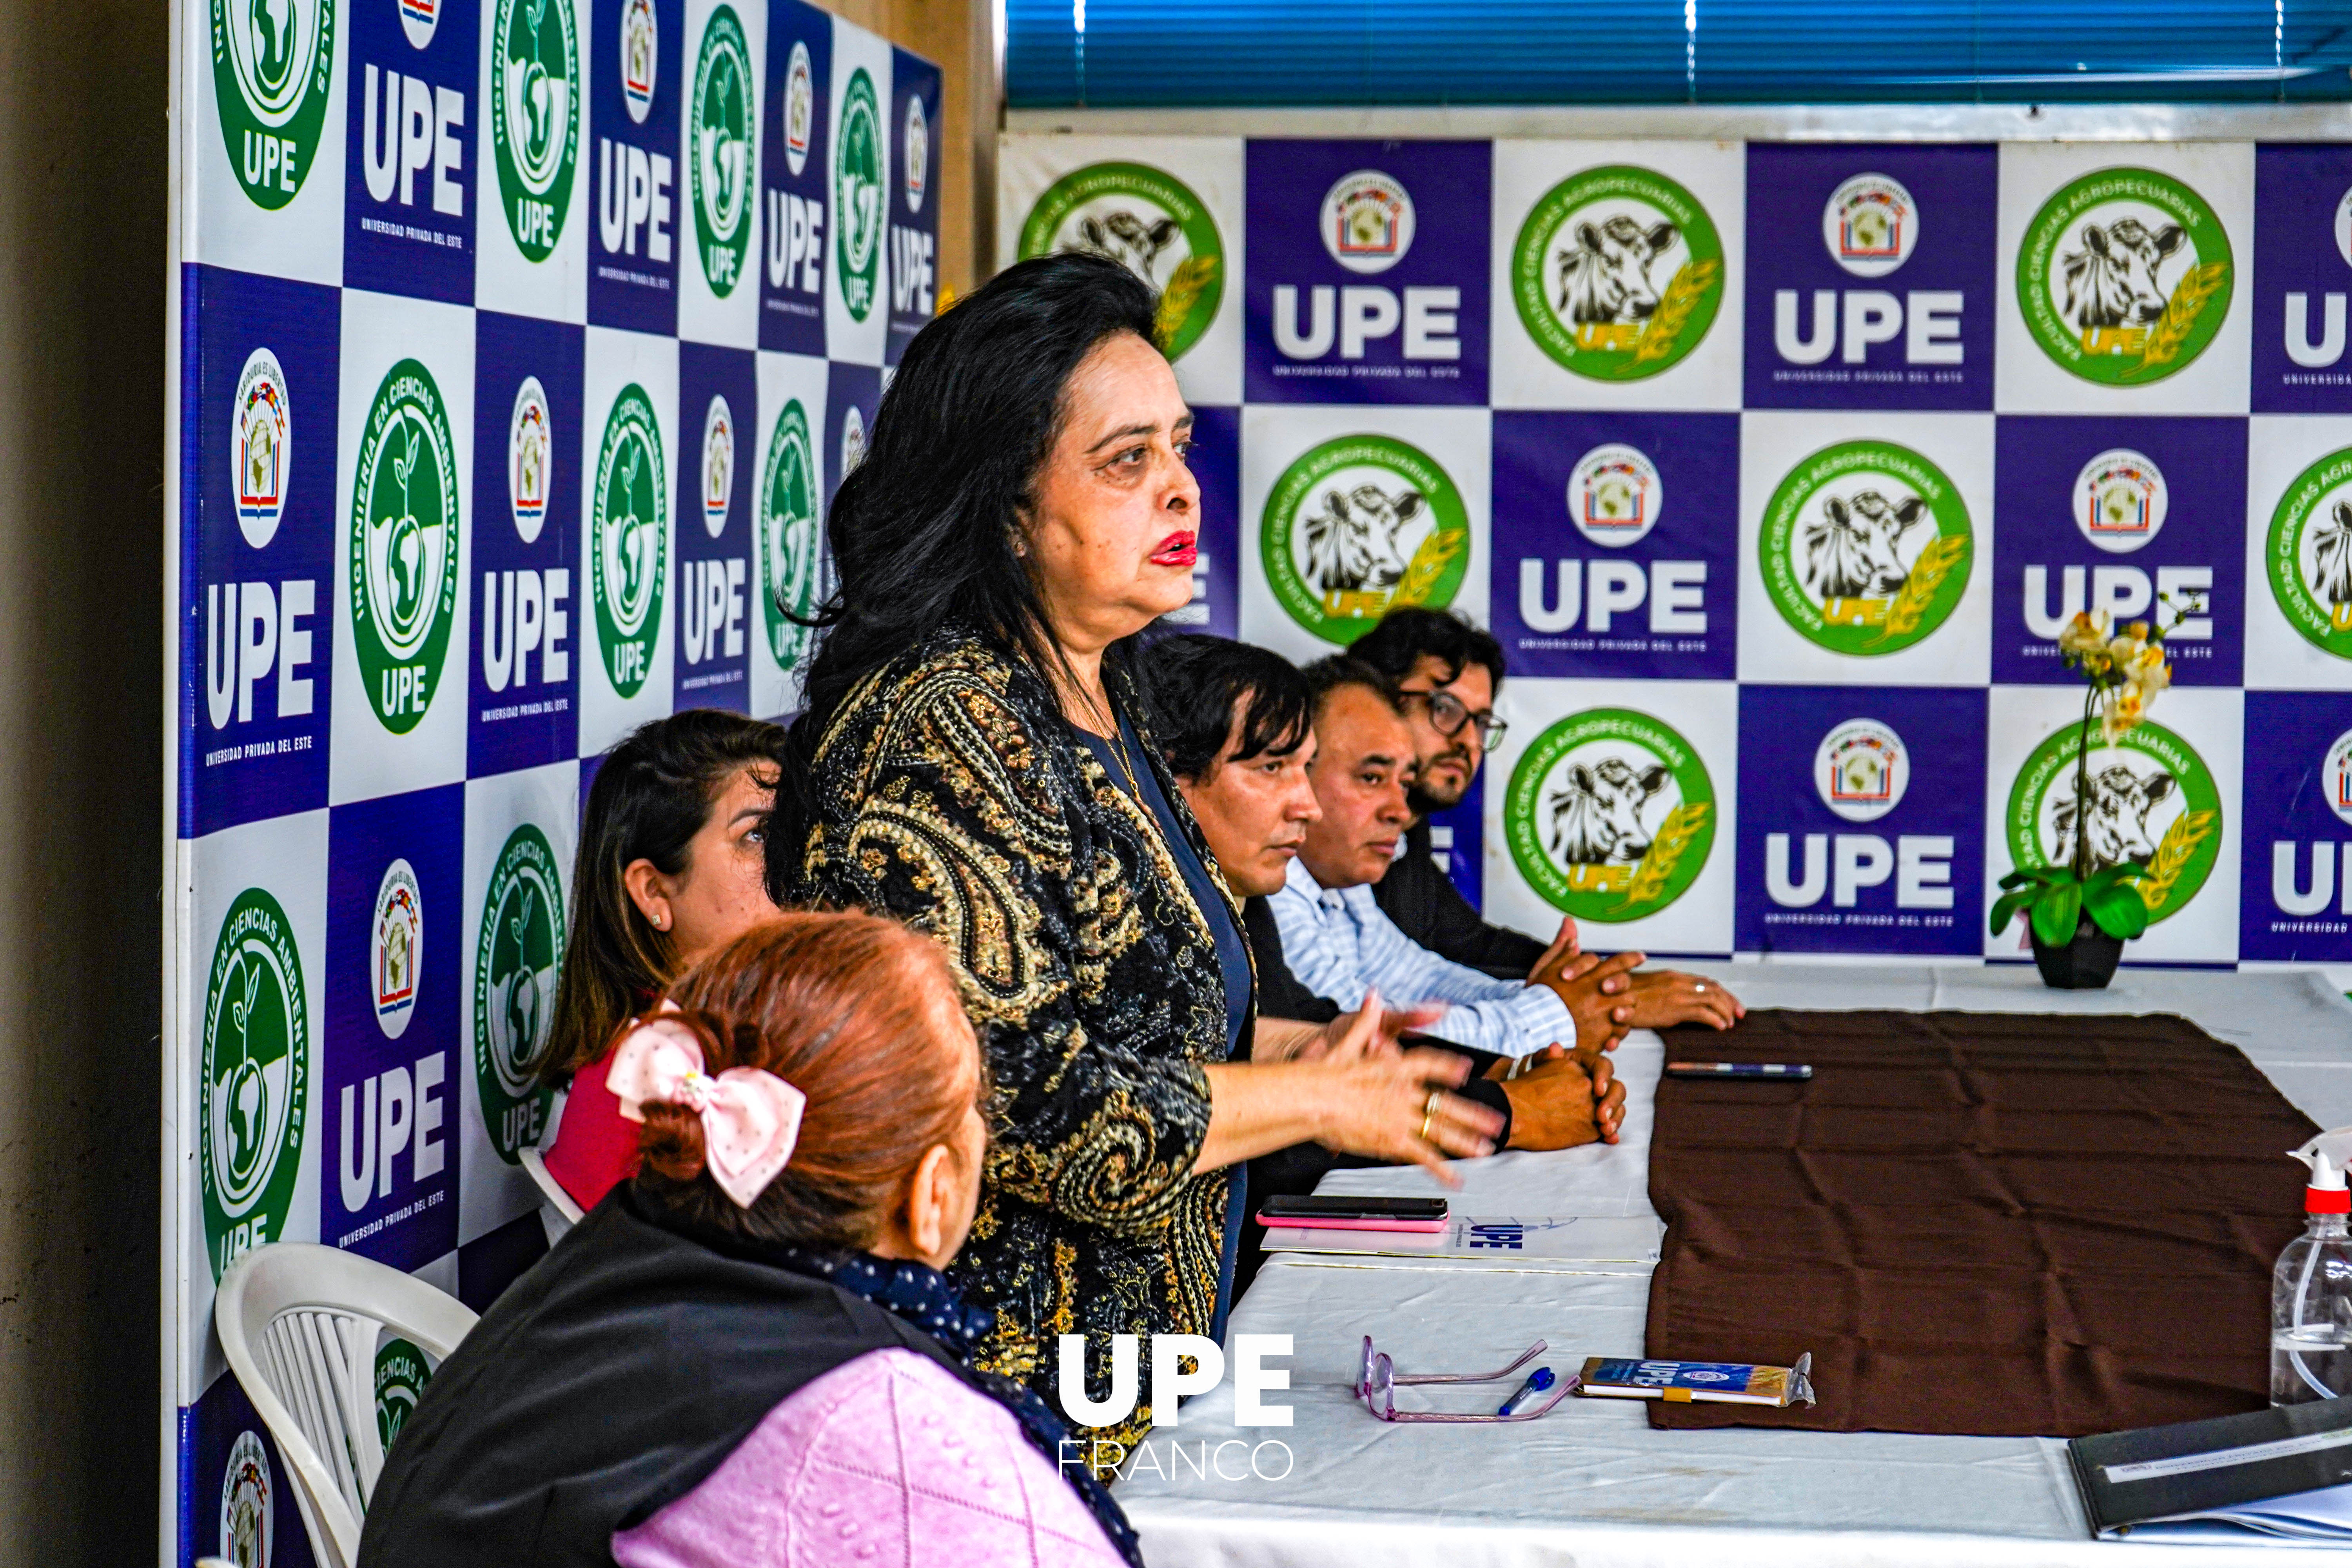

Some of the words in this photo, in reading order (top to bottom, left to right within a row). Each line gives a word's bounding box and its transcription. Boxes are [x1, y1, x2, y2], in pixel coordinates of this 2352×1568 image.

[244, 129, 296, 193] UPE
[364, 63, 464, 216] UPE
[517, 197, 553, 248] UPE
[600, 137, 672, 262] UPE
[709, 245, 736, 287] UPE
[768, 187, 824, 294] UPE
[892, 225, 934, 315] UPE
[848, 276, 871, 310] UPE
[1272, 285, 1461, 359] UPE
[1775, 289, 1964, 364] UPE
[2283, 374, 2352, 385] UNIVERSIDA
[374, 397, 389, 433] EN
[390, 376, 434, 415] CIENCIAS
[432, 414, 455, 614] AMBIENTALES
[2280, 481, 2319, 557] CIENCIAS
[484, 568, 570, 692] UPE
[684, 559, 746, 665] UPE
[1520, 559, 1707, 633] UPE
[2023, 565, 2212, 640] UPE
[207, 580, 315, 730] UPE
[381, 665, 425, 717] UPE
[613, 640, 645, 684] UPE
[206, 746, 242, 767] UNIVERSIDAD
[245, 741, 275, 758] PRIVADA
[278, 739, 291, 753] DEL
[294, 735, 312, 750] ESTE
[1765, 833, 1955, 907] UPE
[2272, 922, 2348, 933] UNIVERSIDAD
[216, 942, 227, 983] EN
[229, 908, 277, 942] CIENCIAS
[277, 937, 305, 1149] AMBIENTALES
[341, 1051, 445, 1212] UPE
[502, 1098, 541, 1152] UPE
[339, 1219, 383, 1249] UNIVERSIDAD
[385, 1205, 412, 1227] PRIVADA
[414, 1200, 426, 1213] DEL
[428, 1190, 444, 1206] ESTE
[1470, 1225, 1523, 1249] UPE
[375, 1356, 416, 1390] IENCIAS
[1633, 1362, 1681, 1385] UPE
